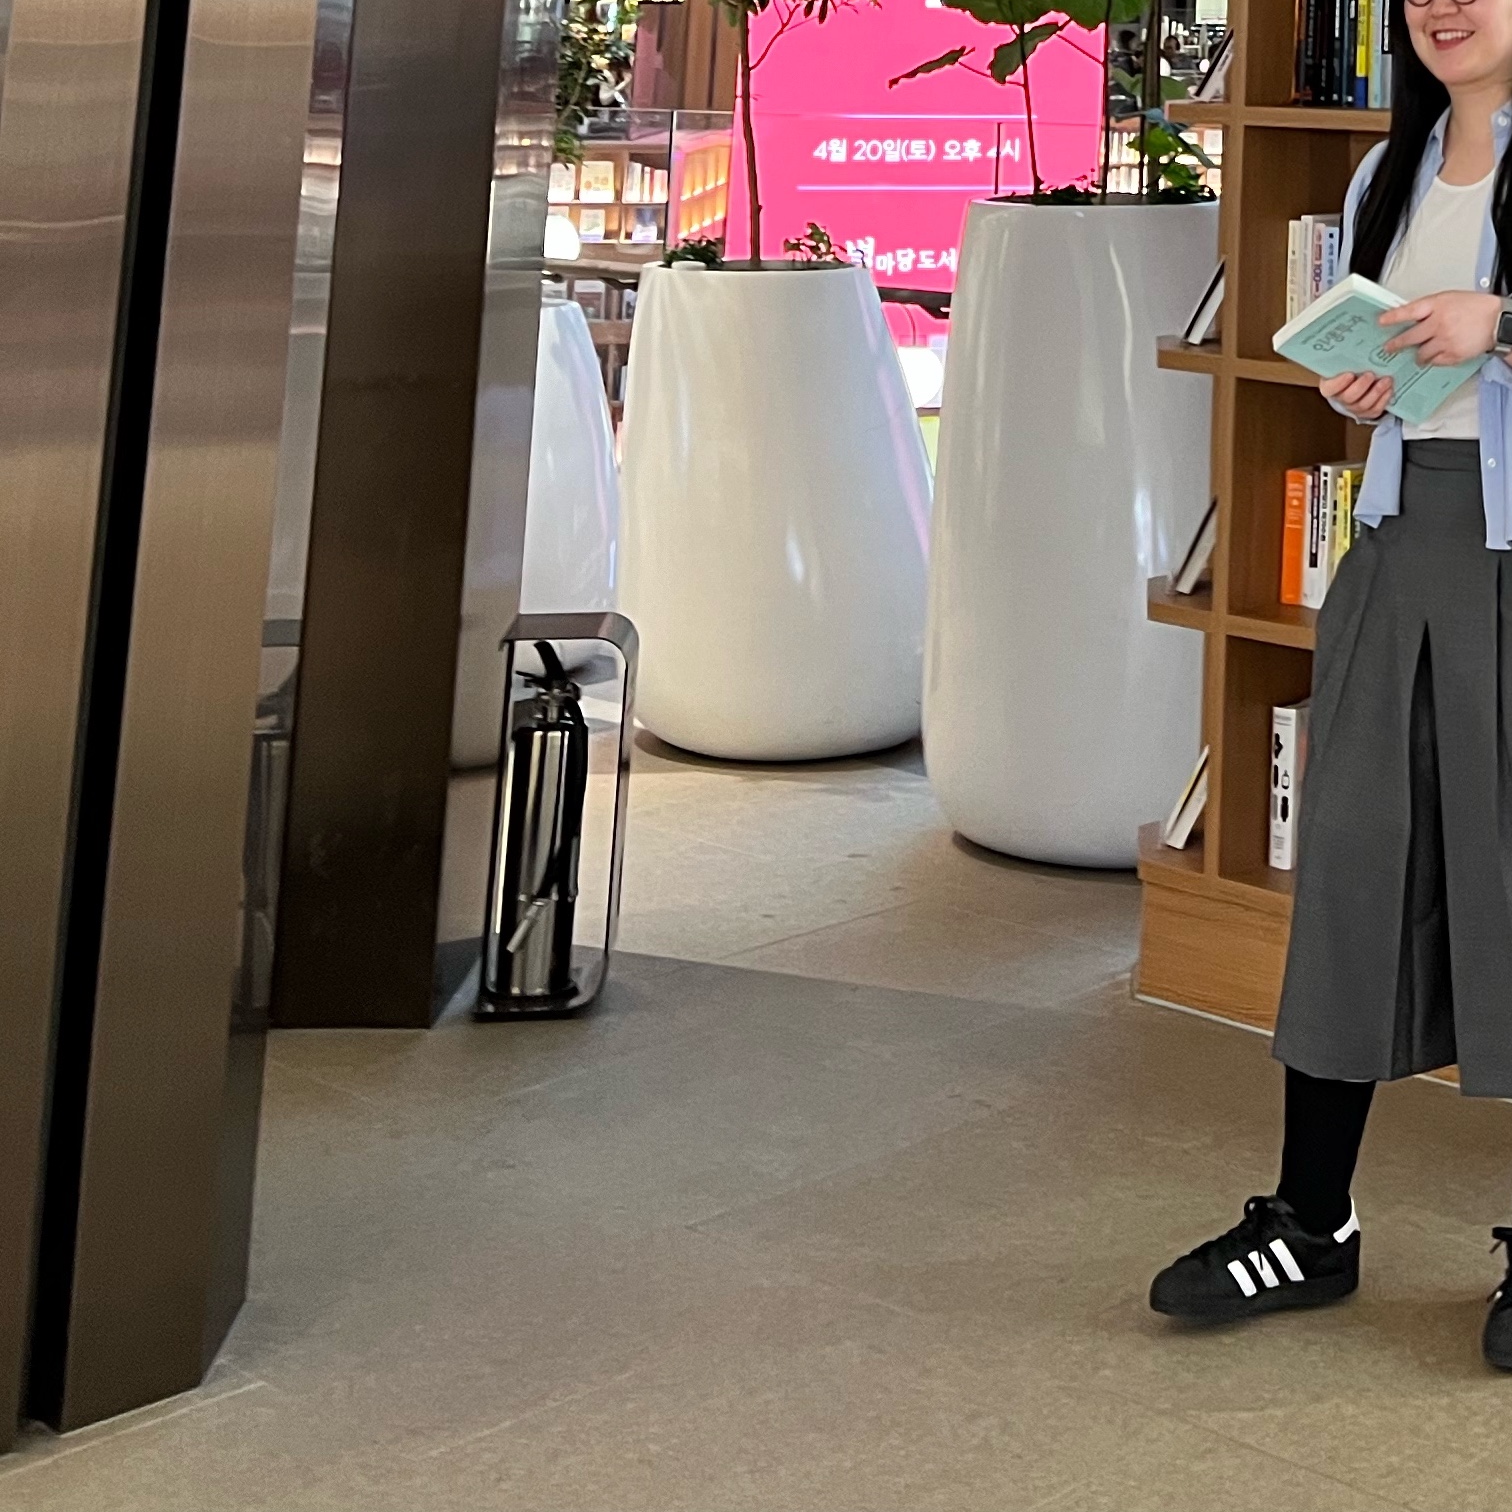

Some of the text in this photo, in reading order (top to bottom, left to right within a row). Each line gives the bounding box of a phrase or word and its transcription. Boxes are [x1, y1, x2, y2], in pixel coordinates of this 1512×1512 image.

[813, 139, 847, 163] 4월
[853, 139, 936, 163] 20일(토)
[943, 139, 982, 163] 오후
[846, 236, 957, 276] 별마당도서
